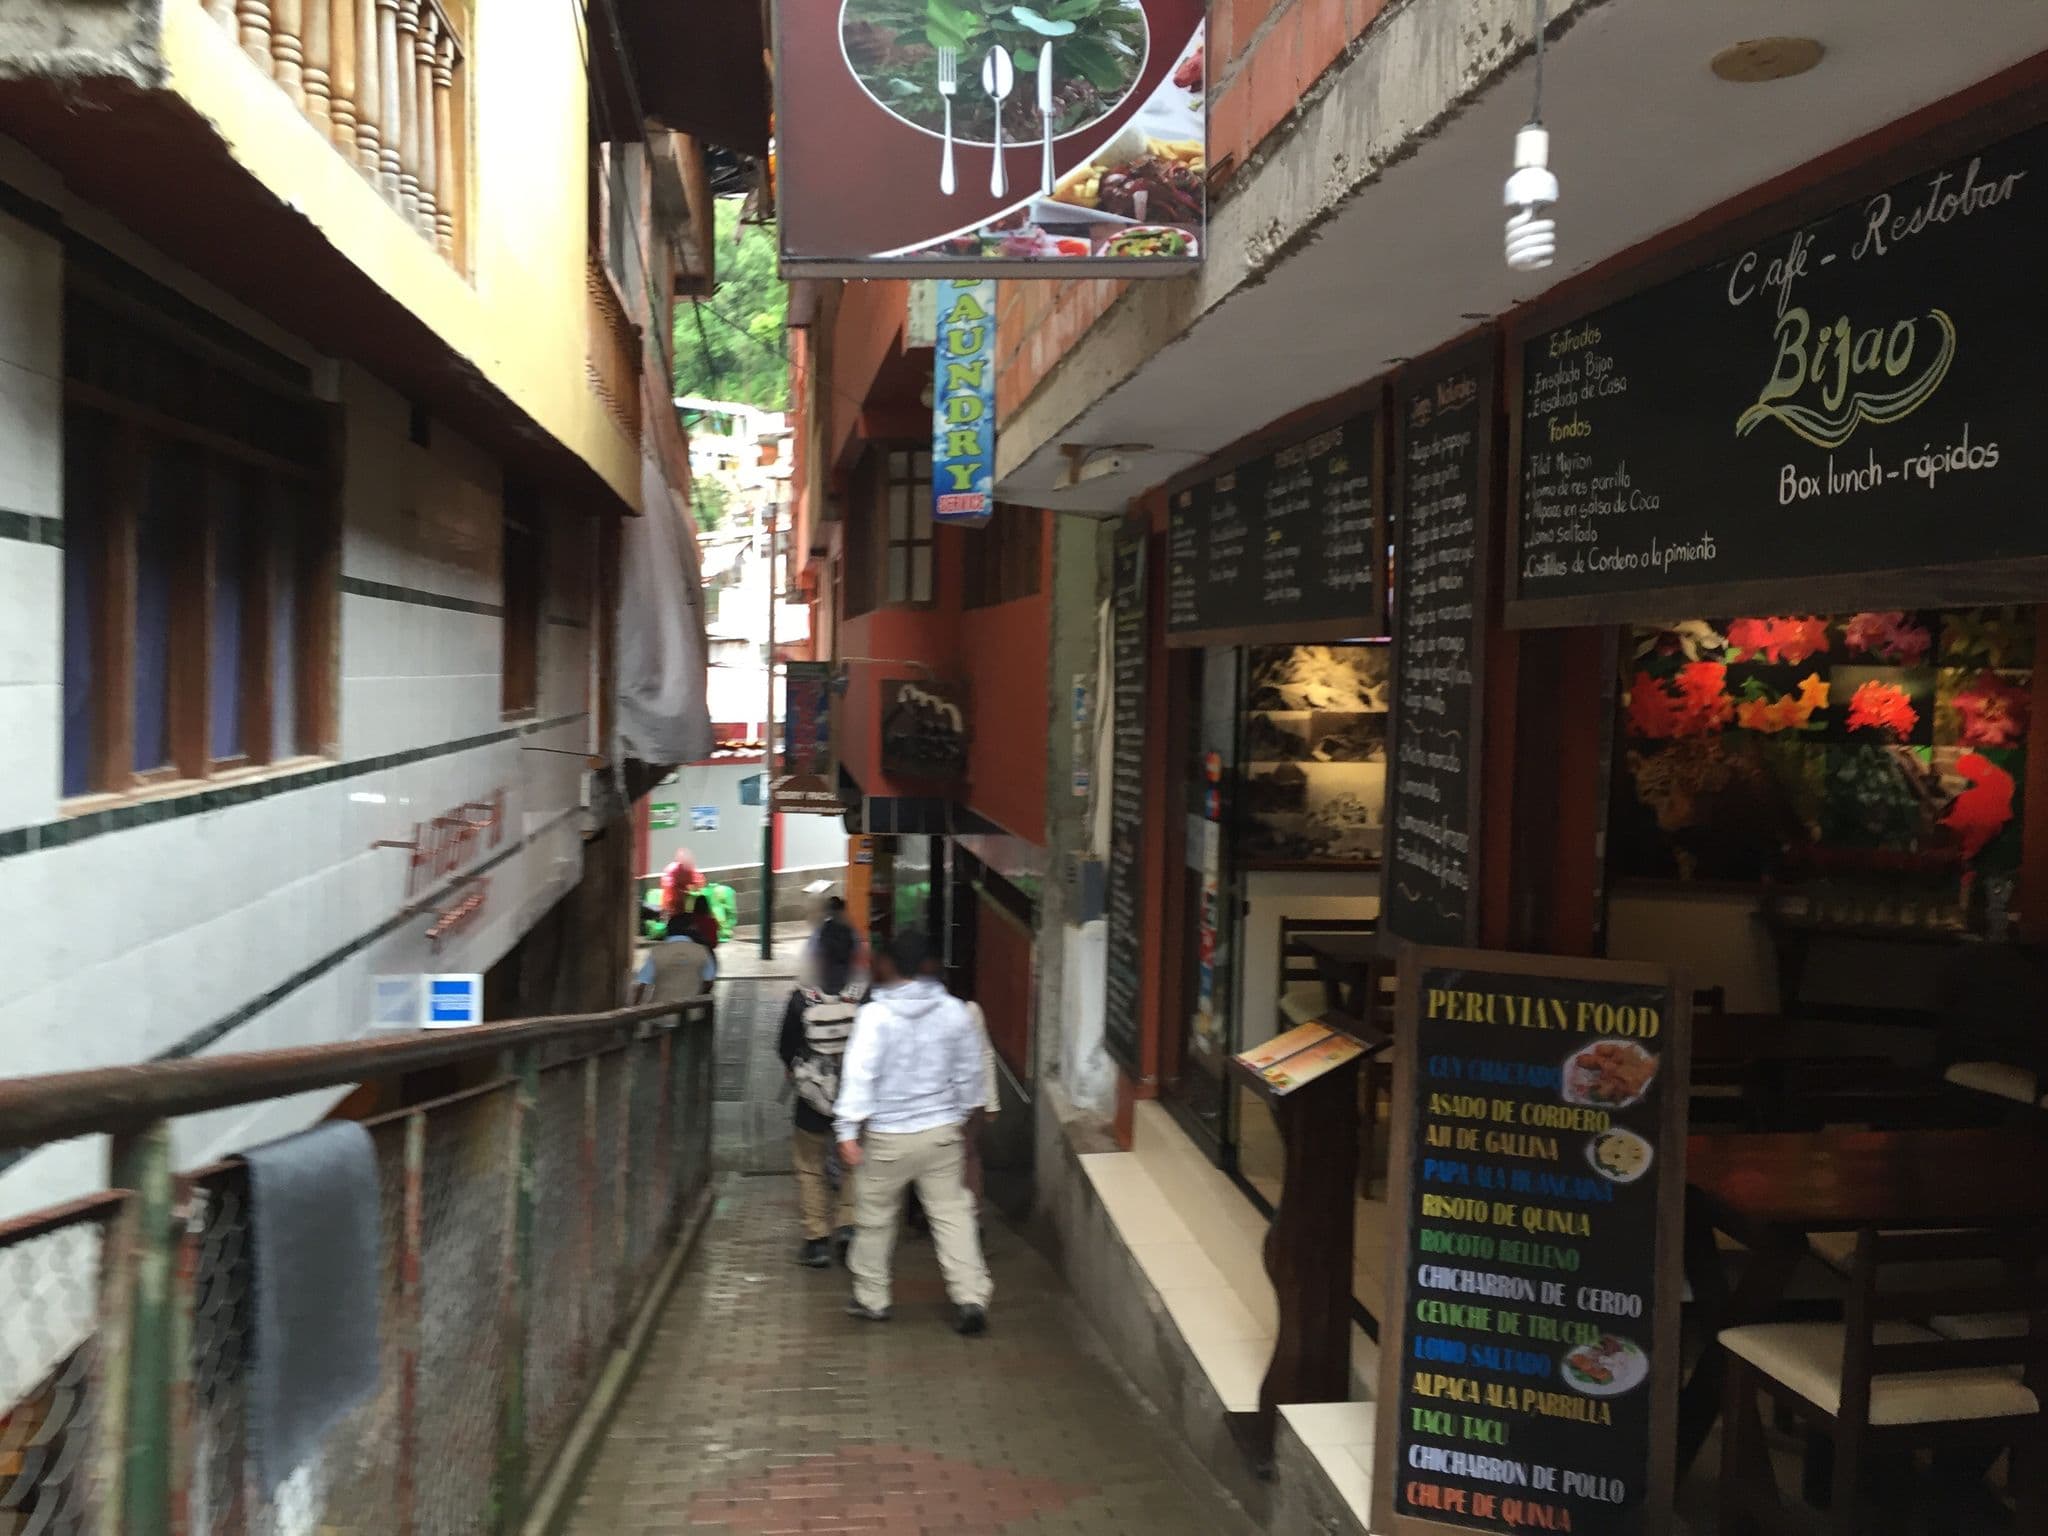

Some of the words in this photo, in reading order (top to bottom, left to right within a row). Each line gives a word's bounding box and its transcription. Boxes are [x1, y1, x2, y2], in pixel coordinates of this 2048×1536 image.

[1728, 231, 1816, 319] Café
[1852, 157, 2028, 261] Restobar
[1759, 306, 1918, 410] Bijao
[944, 279, 988, 490] AUNDRY
[1581, 378, 1596, 400] de
[1779, 463, 1821, 505] Box
[1571, 550, 1585, 574] de
[1426, 988, 1569, 1031] PERUVIAN
[1575, 1000, 1660, 1039] FOOD
[1428, 1093, 1487, 1120] ASADO
[1491, 1098, 1517, 1123] DE
[1520, 1102, 1611, 1133] CORDERO
[1456, 1127, 1481, 1151] DE
[1485, 1131, 1561, 1161] GALLINA
[1491, 1201, 1518, 1227] DE
[1498, 1238, 1581, 1272] RELLENO
[1418, 1263, 1536, 1302] CHICHARRON
[1539, 1280, 1567, 1307] DE
[1576, 1286, 1643, 1319] CERDO
[1415, 1298, 1491, 1332] CEVICHE
[1496, 1310, 1522, 1336] DE
[1412, 1371, 1482, 1405] ALPACA
[1521, 1387, 1613, 1426] PARRILLA
[1409, 1443, 1528, 1487] CHICHARRON
[1531, 1464, 1559, 1493] DE
[1562, 1469, 1626, 1505] POLLO
[1471, 1492, 1498, 1519] DE
